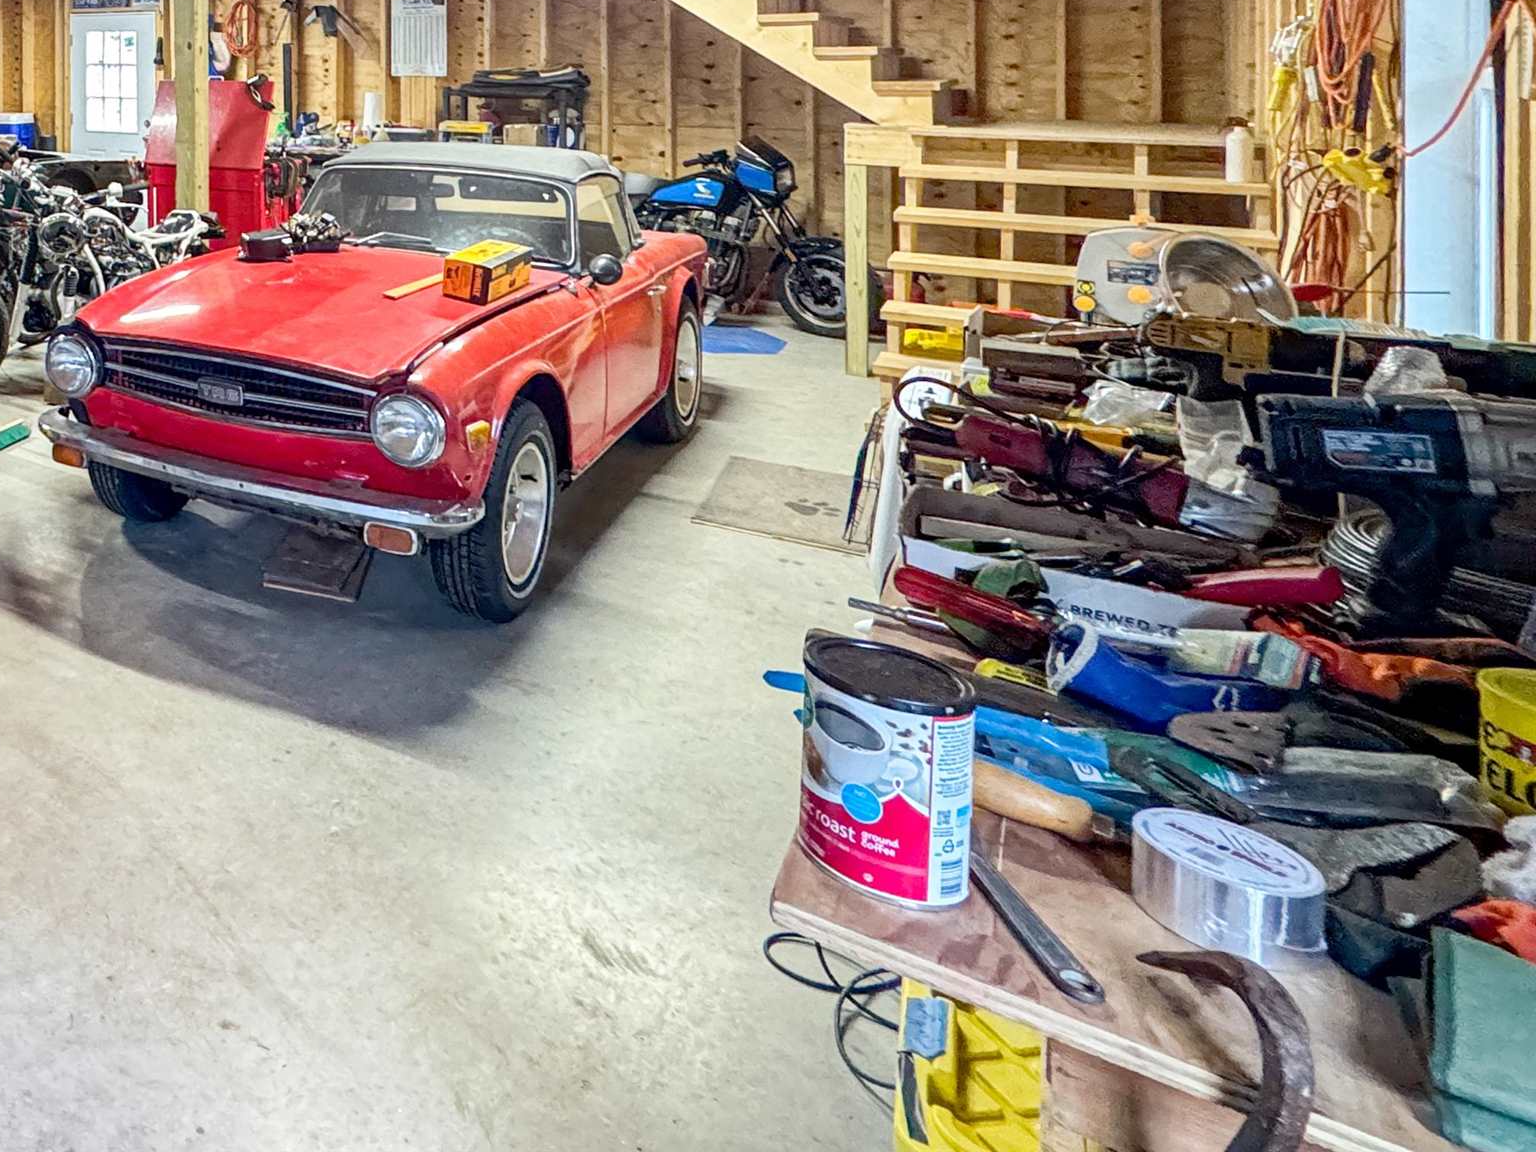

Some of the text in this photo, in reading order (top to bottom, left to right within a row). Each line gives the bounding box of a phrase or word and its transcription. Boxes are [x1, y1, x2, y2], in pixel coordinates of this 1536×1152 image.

[199, 382, 240, 402] TR6
[1069, 604, 1151, 631] BREWED
[815, 808, 857, 844] roast
[860, 830, 901, 849] ground
[860, 838, 897, 858] coffee
